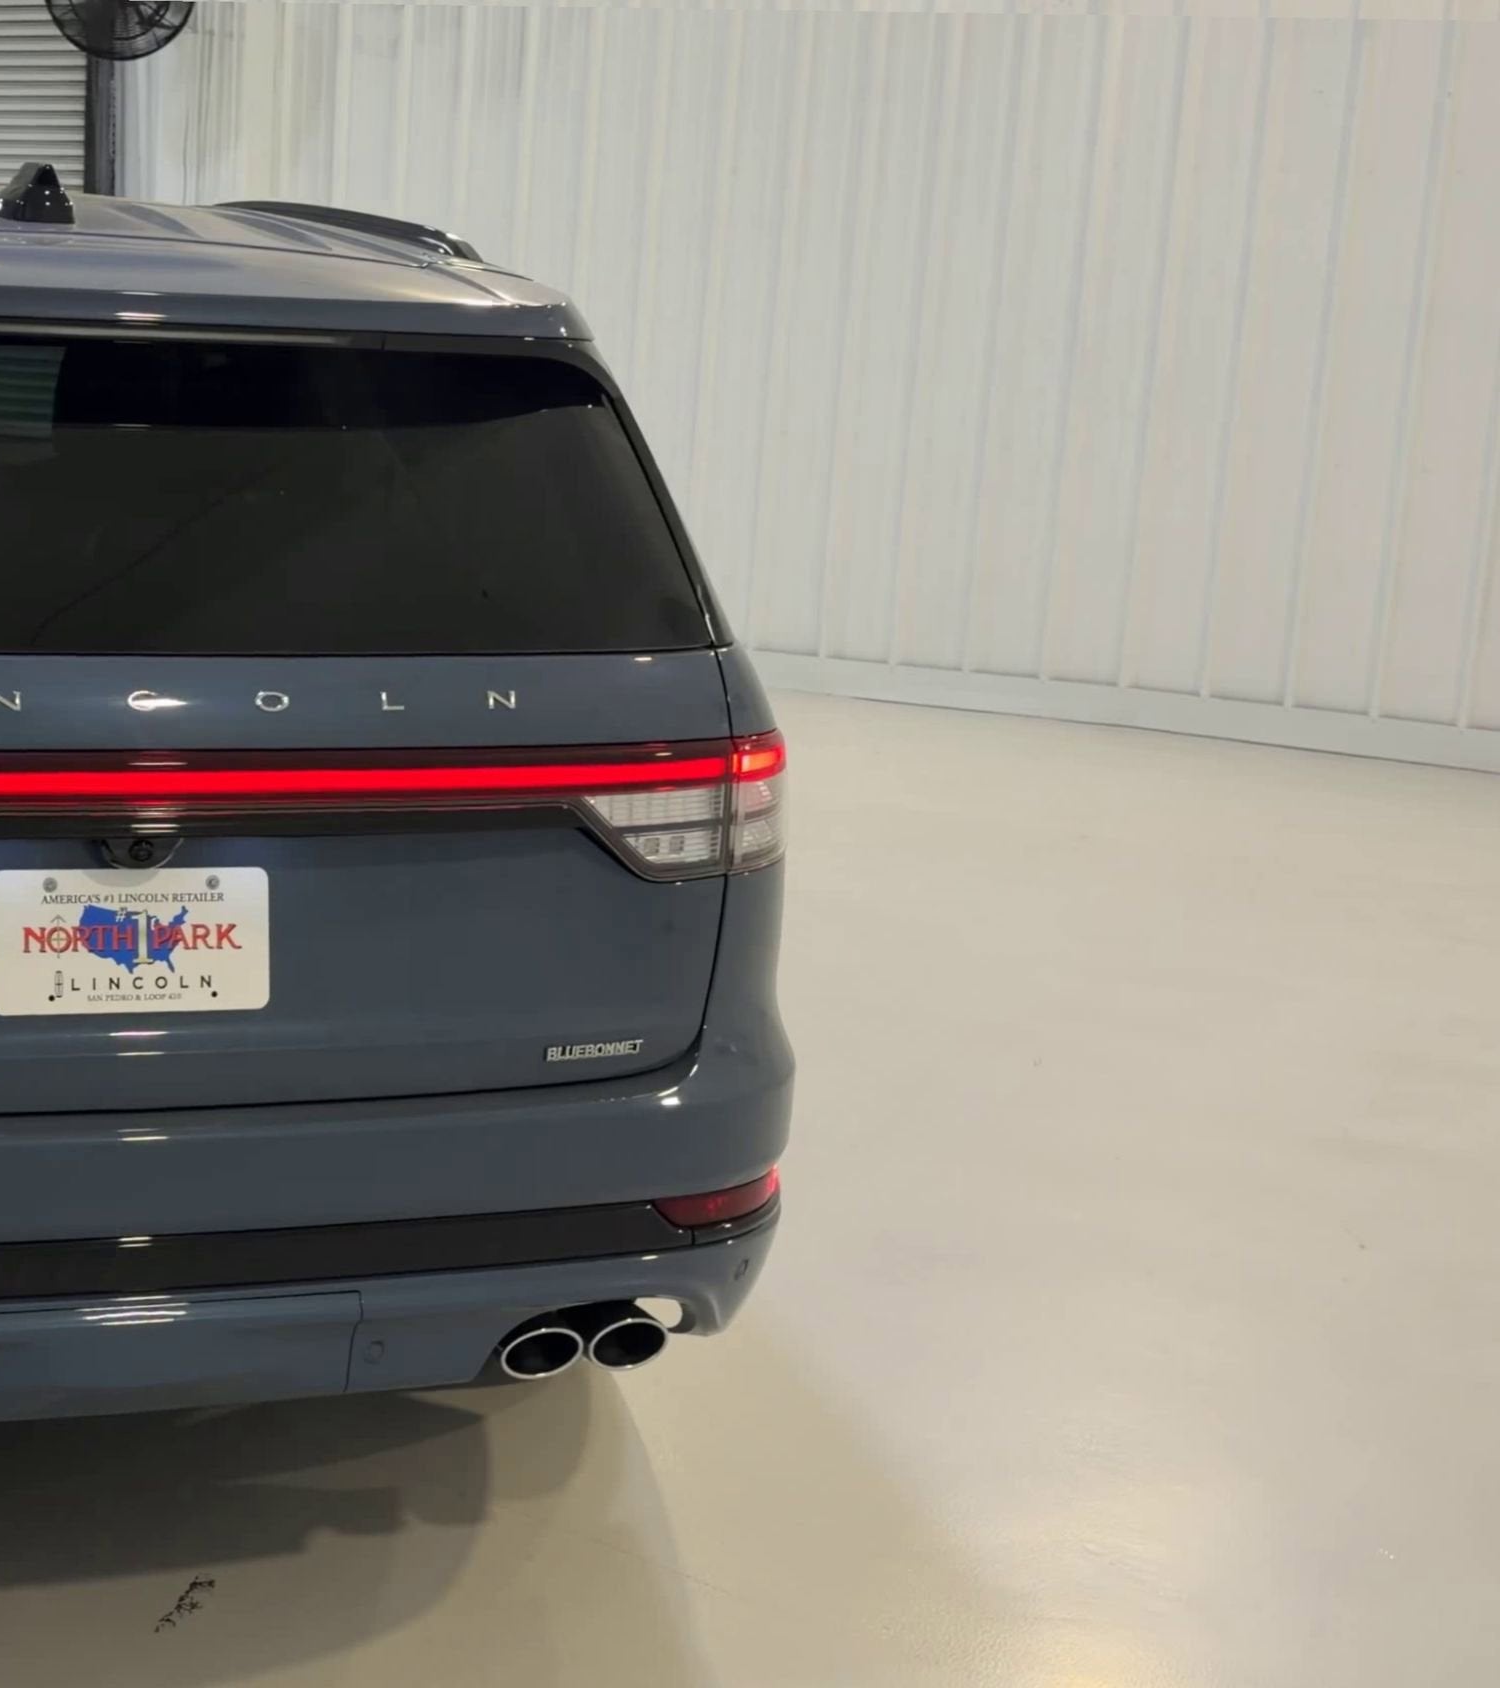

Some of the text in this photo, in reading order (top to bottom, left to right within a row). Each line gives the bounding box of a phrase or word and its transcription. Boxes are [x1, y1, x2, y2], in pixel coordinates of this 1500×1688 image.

[41, 892, 225, 905] AMERICA'S #1 LINCOLN RETAILER
[22, 924, 243, 954] NORTH PARK
[71, 975, 213, 991] LINCOLN
[546, 1039, 644, 1062] BLUEBONNET
